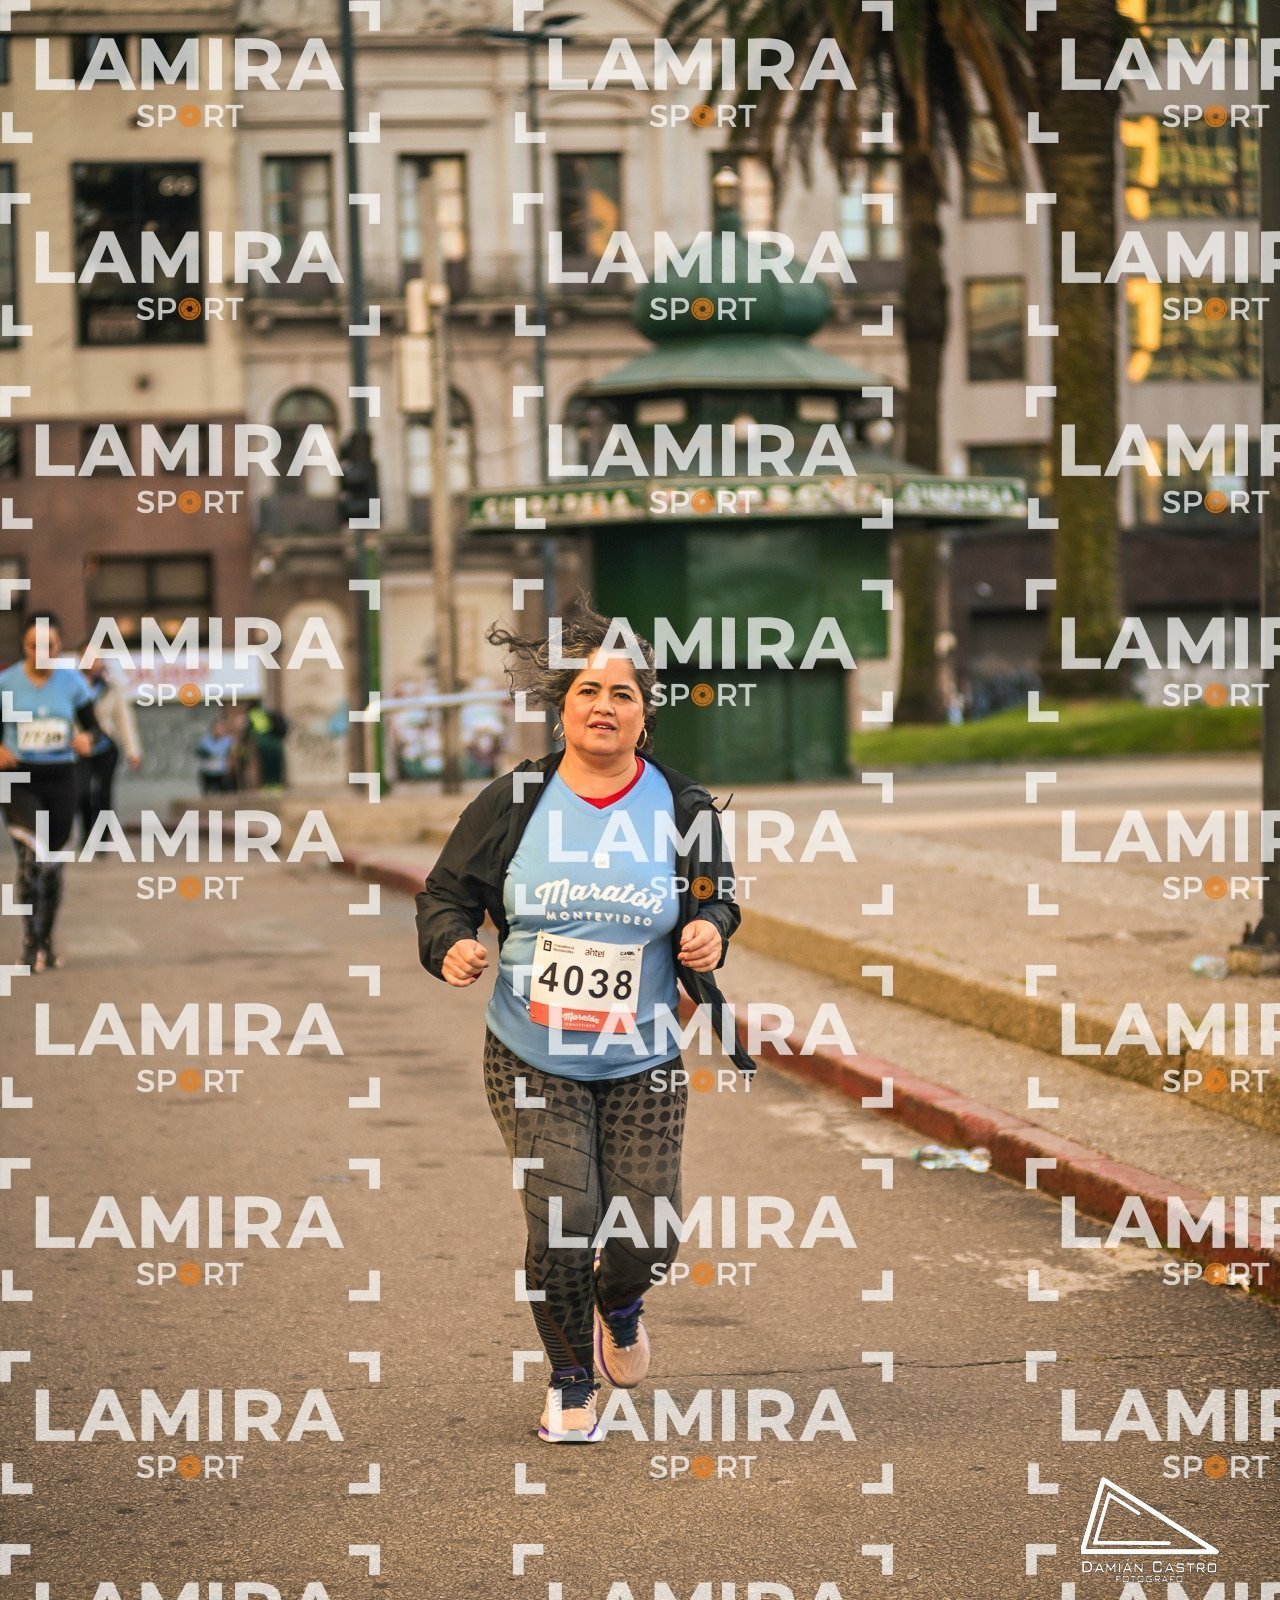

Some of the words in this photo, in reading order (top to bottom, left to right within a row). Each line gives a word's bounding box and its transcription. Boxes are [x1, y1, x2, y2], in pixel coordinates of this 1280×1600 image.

[535, 878, 664, 914] Maratón
[545, 911, 653, 927] MONTEVIDEO
[584, 947, 605, 958] antel
[538, 961, 633, 1001] 4038
